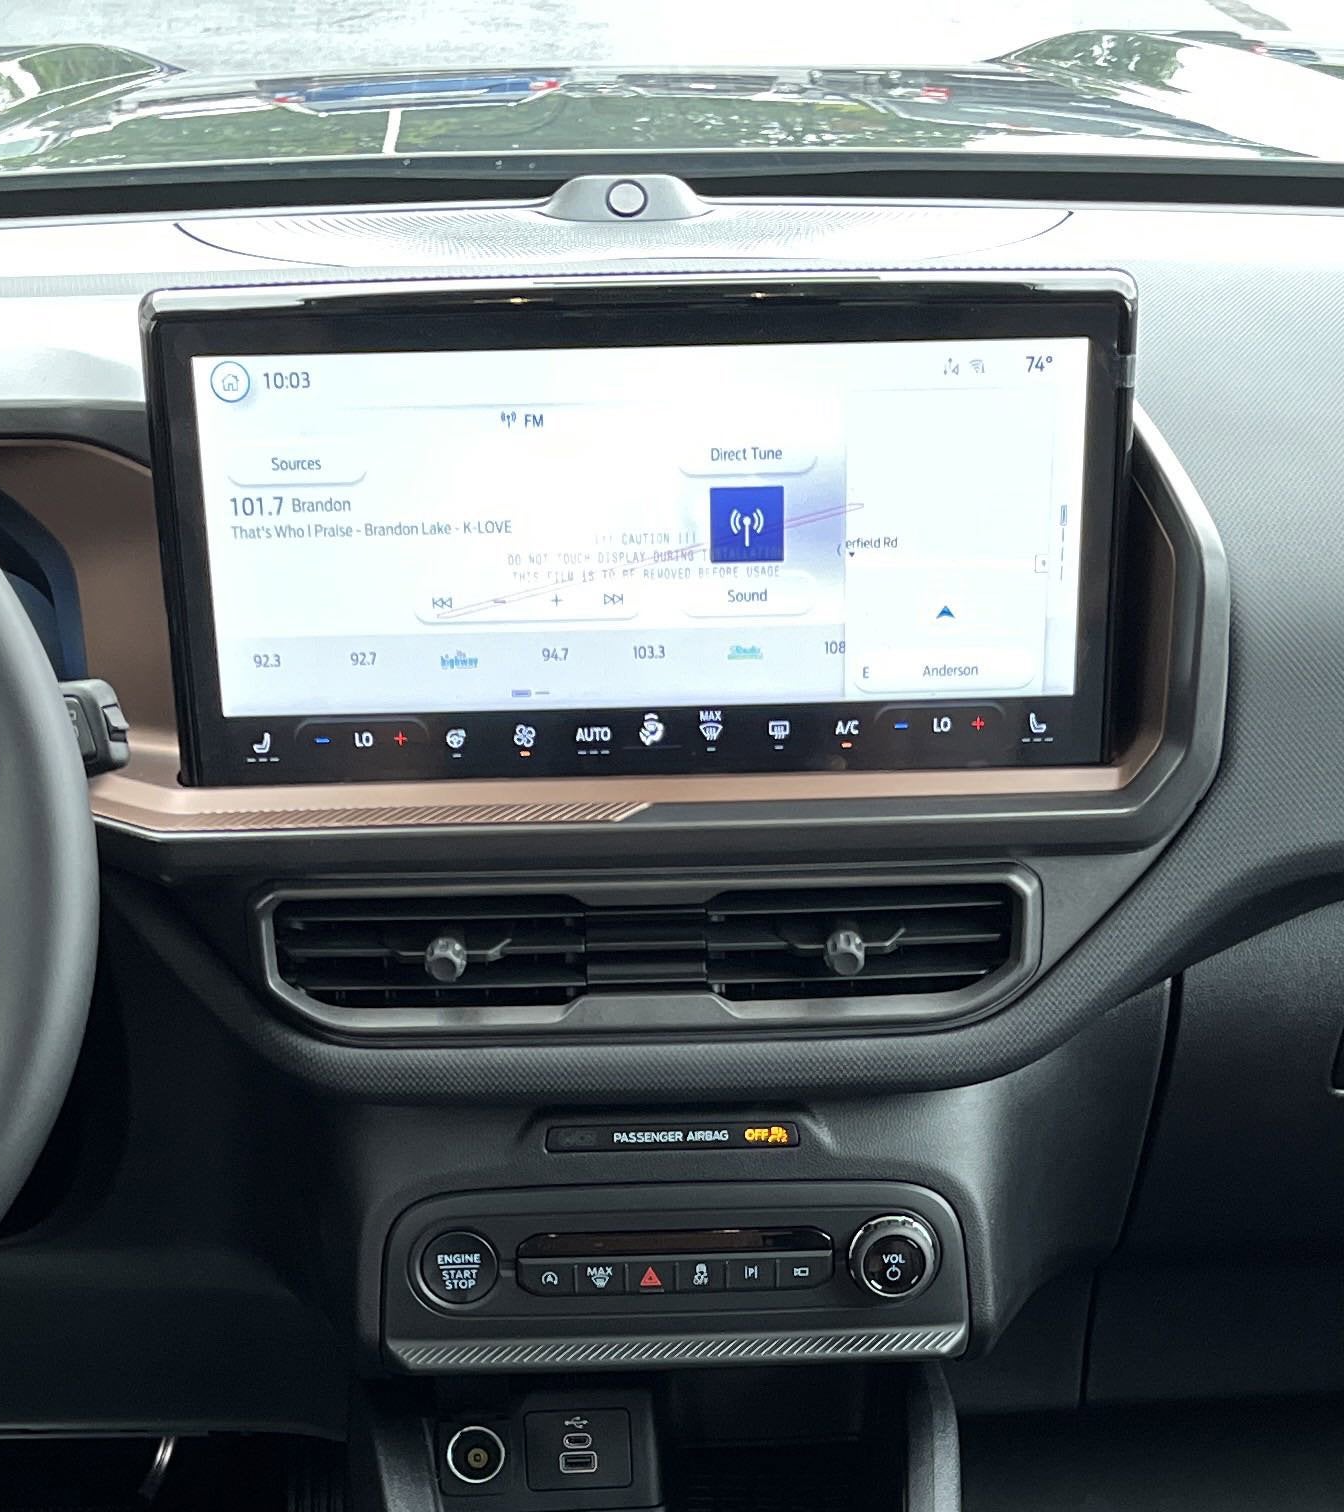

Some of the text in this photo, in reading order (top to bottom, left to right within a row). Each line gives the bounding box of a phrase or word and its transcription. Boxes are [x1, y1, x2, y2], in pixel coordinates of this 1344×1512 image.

[1025, 357, 1053, 373] 74°
[262, 372, 311, 390] 10:03
[524, 414, 544, 427] FM
[710, 447, 783, 462] Direct Tune
[271, 457, 322, 471] Sources
[230, 497, 351, 517] 101.7 Brandon
[231, 520, 512, 539] That's Who I Praise Brandon Lake K-LOVE
[621, 532, 670, 546] CAUTION
[883, 537, 898, 548] Rd
[507, 553, 521, 566] DO
[597, 551, 646, 564] DISPLAY
[643, 567, 691, 580] REMOVED
[698, 566, 739, 579] BEFORE
[746, 564, 780, 578] USAGE
[727, 589, 768, 602] Sound
[350, 652, 377, 666] 92.7
[542, 648, 569, 662] 94.7
[632, 645, 666, 660] 103.3
[253, 654, 281, 668] 92.3
[862, 664, 979, 679] E Anderson
[699, 711, 722, 722] MAX
[835, 720, 859, 736] A/C
[933, 717, 952, 733] LO
[354, 732, 374, 748] LO
[576, 726, 611, 743] AUTO
[613, 1130, 683, 1144] PASSENGER
[687, 1129, 729, 1142] AIRBAG
[744, 1128, 769, 1142] OFF
[437, 1253, 482, 1265] ENGINE
[882, 1253, 906, 1265] VOL
[441, 1269, 478, 1280] START
[587, 1266, 613, 1277] MAX
[445, 1279, 476, 1290] STOP
